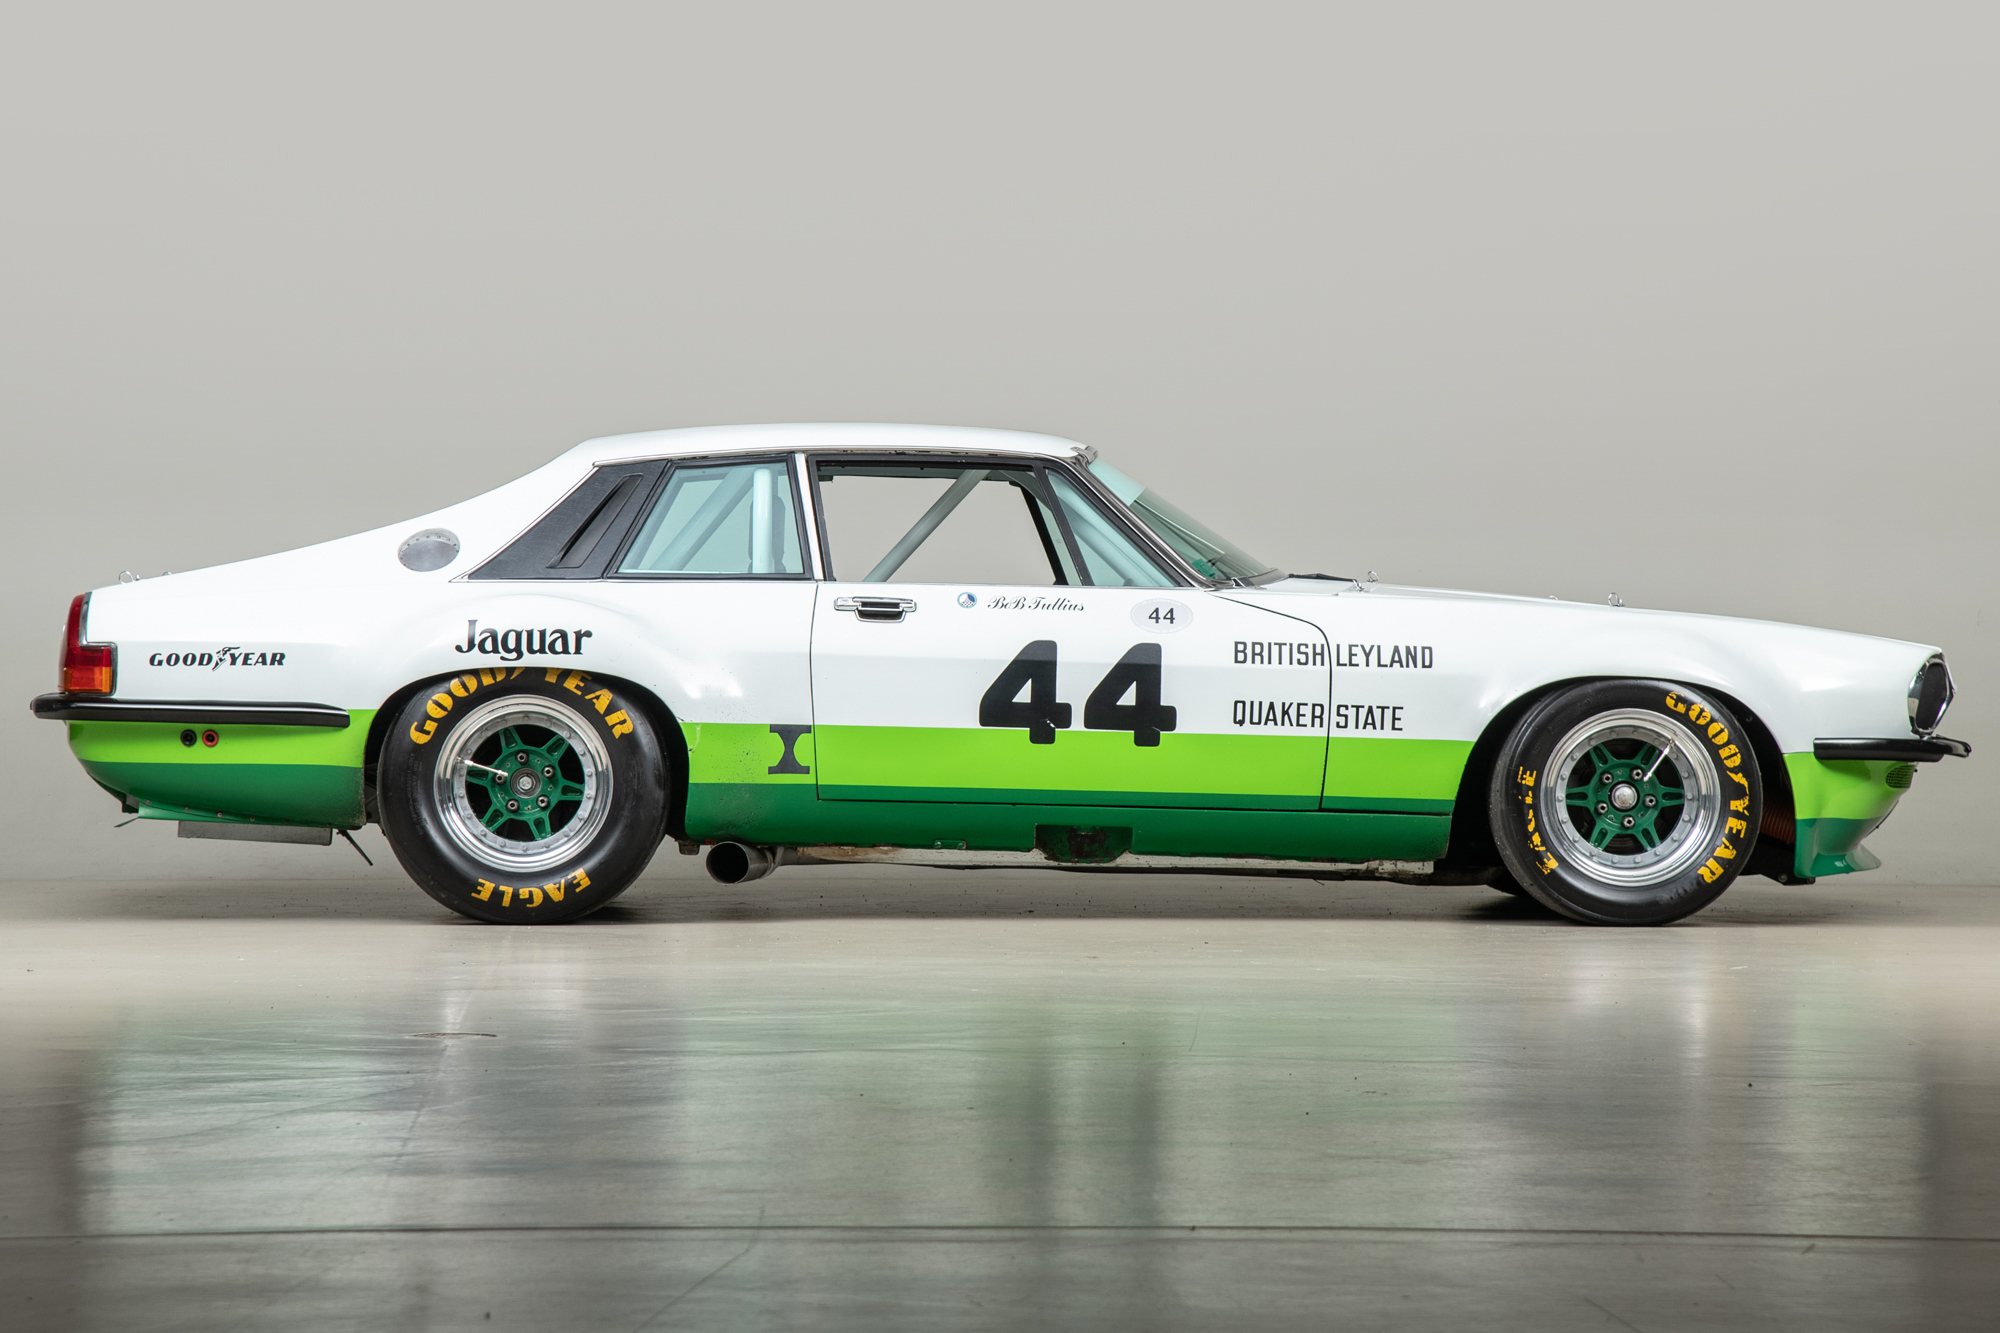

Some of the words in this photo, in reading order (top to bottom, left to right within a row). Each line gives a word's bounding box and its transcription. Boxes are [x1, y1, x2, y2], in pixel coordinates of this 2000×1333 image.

[1028, 596, 1085, 612] Tullius
[1148, 606, 1176, 625] 44
[455, 619, 593, 661] Jaguar
[1234, 641, 1326, 667] BRITISH
[1336, 643, 1434, 669] LEYLAND
[979, 639, 1177, 747] 44
[1233, 700, 1325, 728] QUAKER
[1336, 704, 1404, 732] STATE
[471, 867, 592, 908] EAGLE
